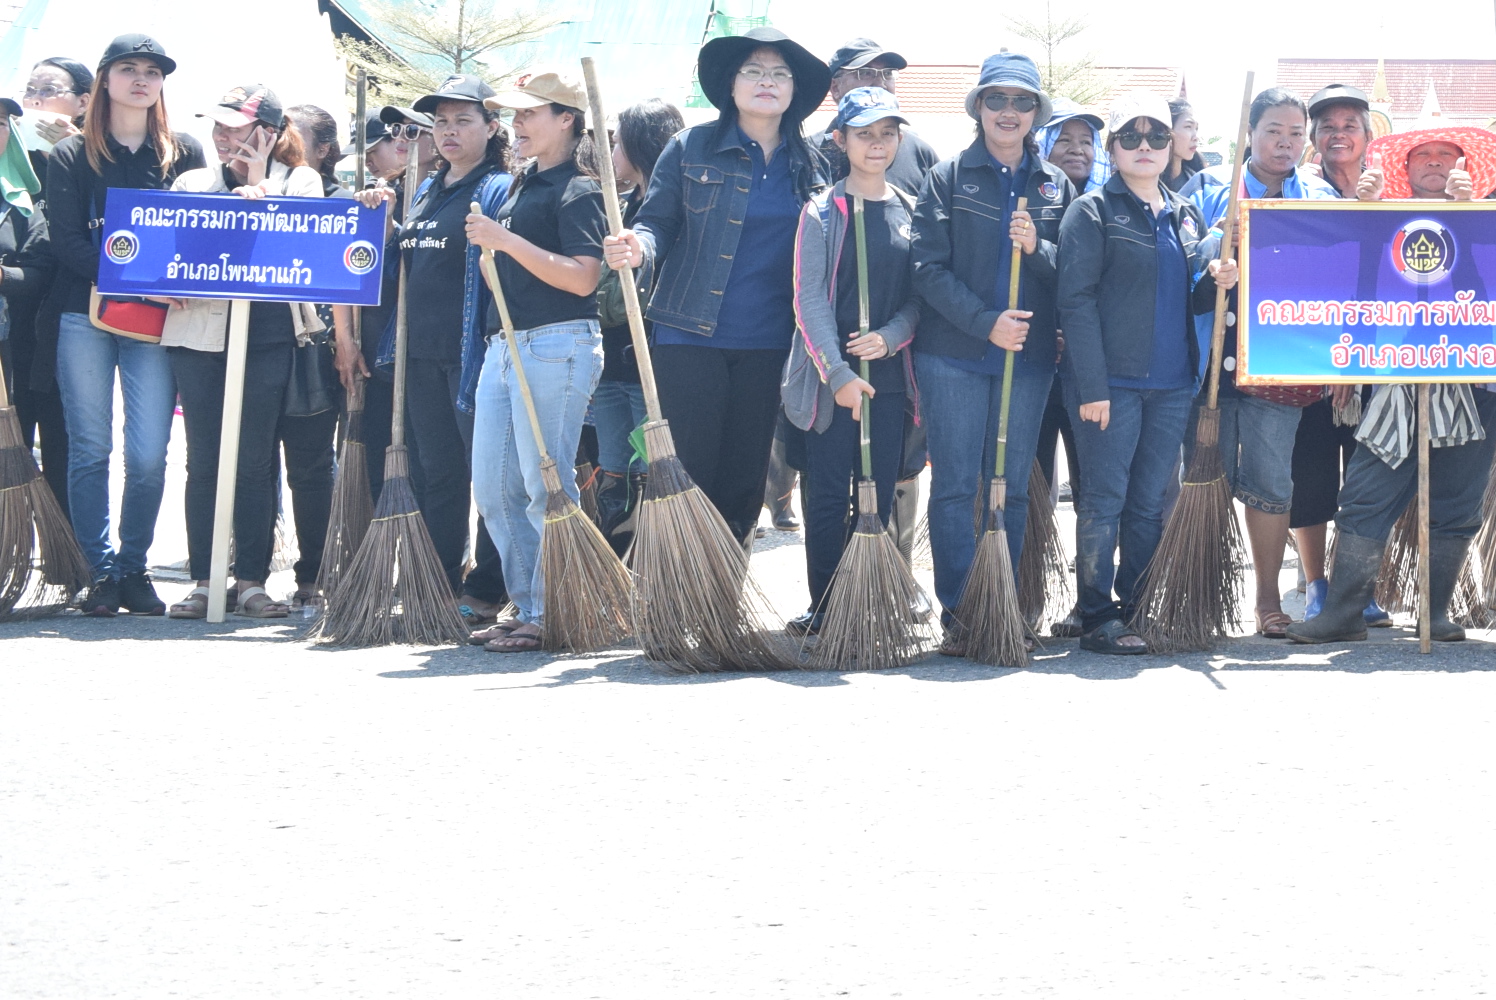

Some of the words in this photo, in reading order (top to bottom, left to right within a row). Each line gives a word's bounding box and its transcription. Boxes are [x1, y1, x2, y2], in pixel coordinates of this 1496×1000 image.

[130, 203, 360, 235] คณะกรรมการพัฒนาสตรี
[166, 253, 312, 286] อำเภอโพนนาแก้ว
